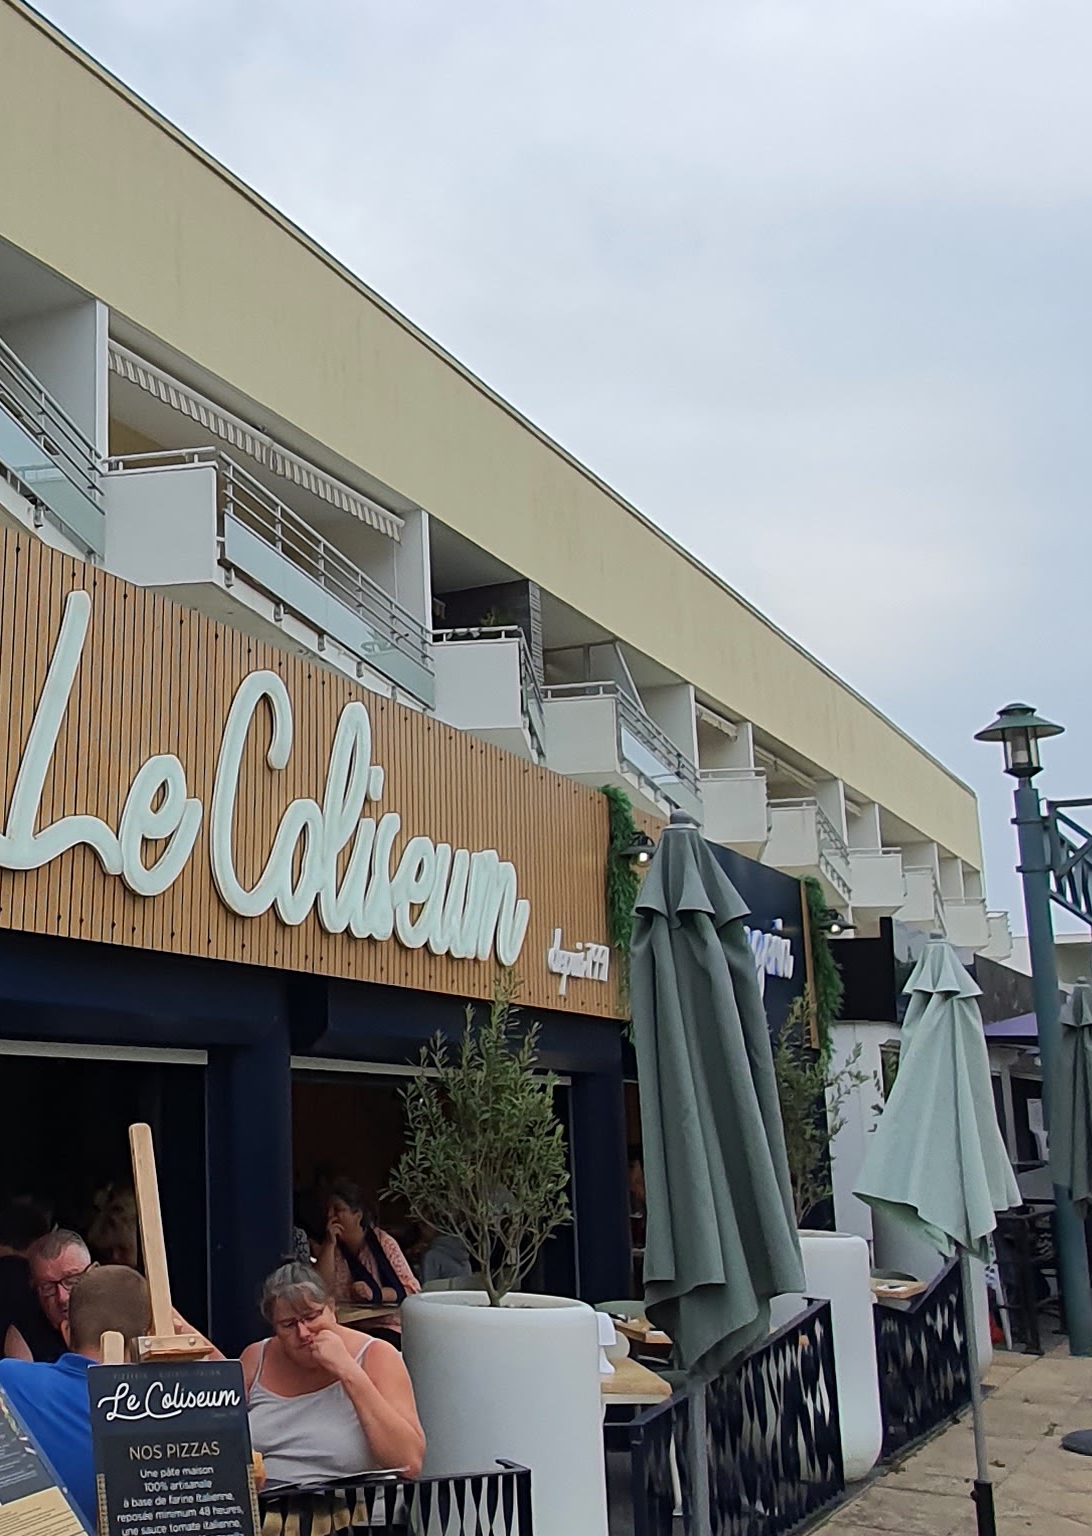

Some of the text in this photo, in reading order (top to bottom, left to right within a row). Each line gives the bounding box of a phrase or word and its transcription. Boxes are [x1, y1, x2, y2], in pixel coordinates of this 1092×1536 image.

[210, 669, 530, 965] Coliseum
[97, 1381, 241, 1421] Le Coliseum
[129, 1441, 220, 1461] NOS PIZZAS
[140, 1466, 214, 1479] Une pâte maison
[144, 1479, 212, 1492] 100% artisanale
[131, 1497, 152, 1507] base
[155, 1495, 167, 1506] de
[169, 1494, 194, 1505] farine
[116, 1511, 153, 1523] reposée
[155, 1508, 196, 1519] minimum
[199, 1507, 211, 1516] 48
[121, 1527, 139, 1536] une
[141, 1525, 167, 1535] sauce
[169, 1522, 201, 1533] tomate
